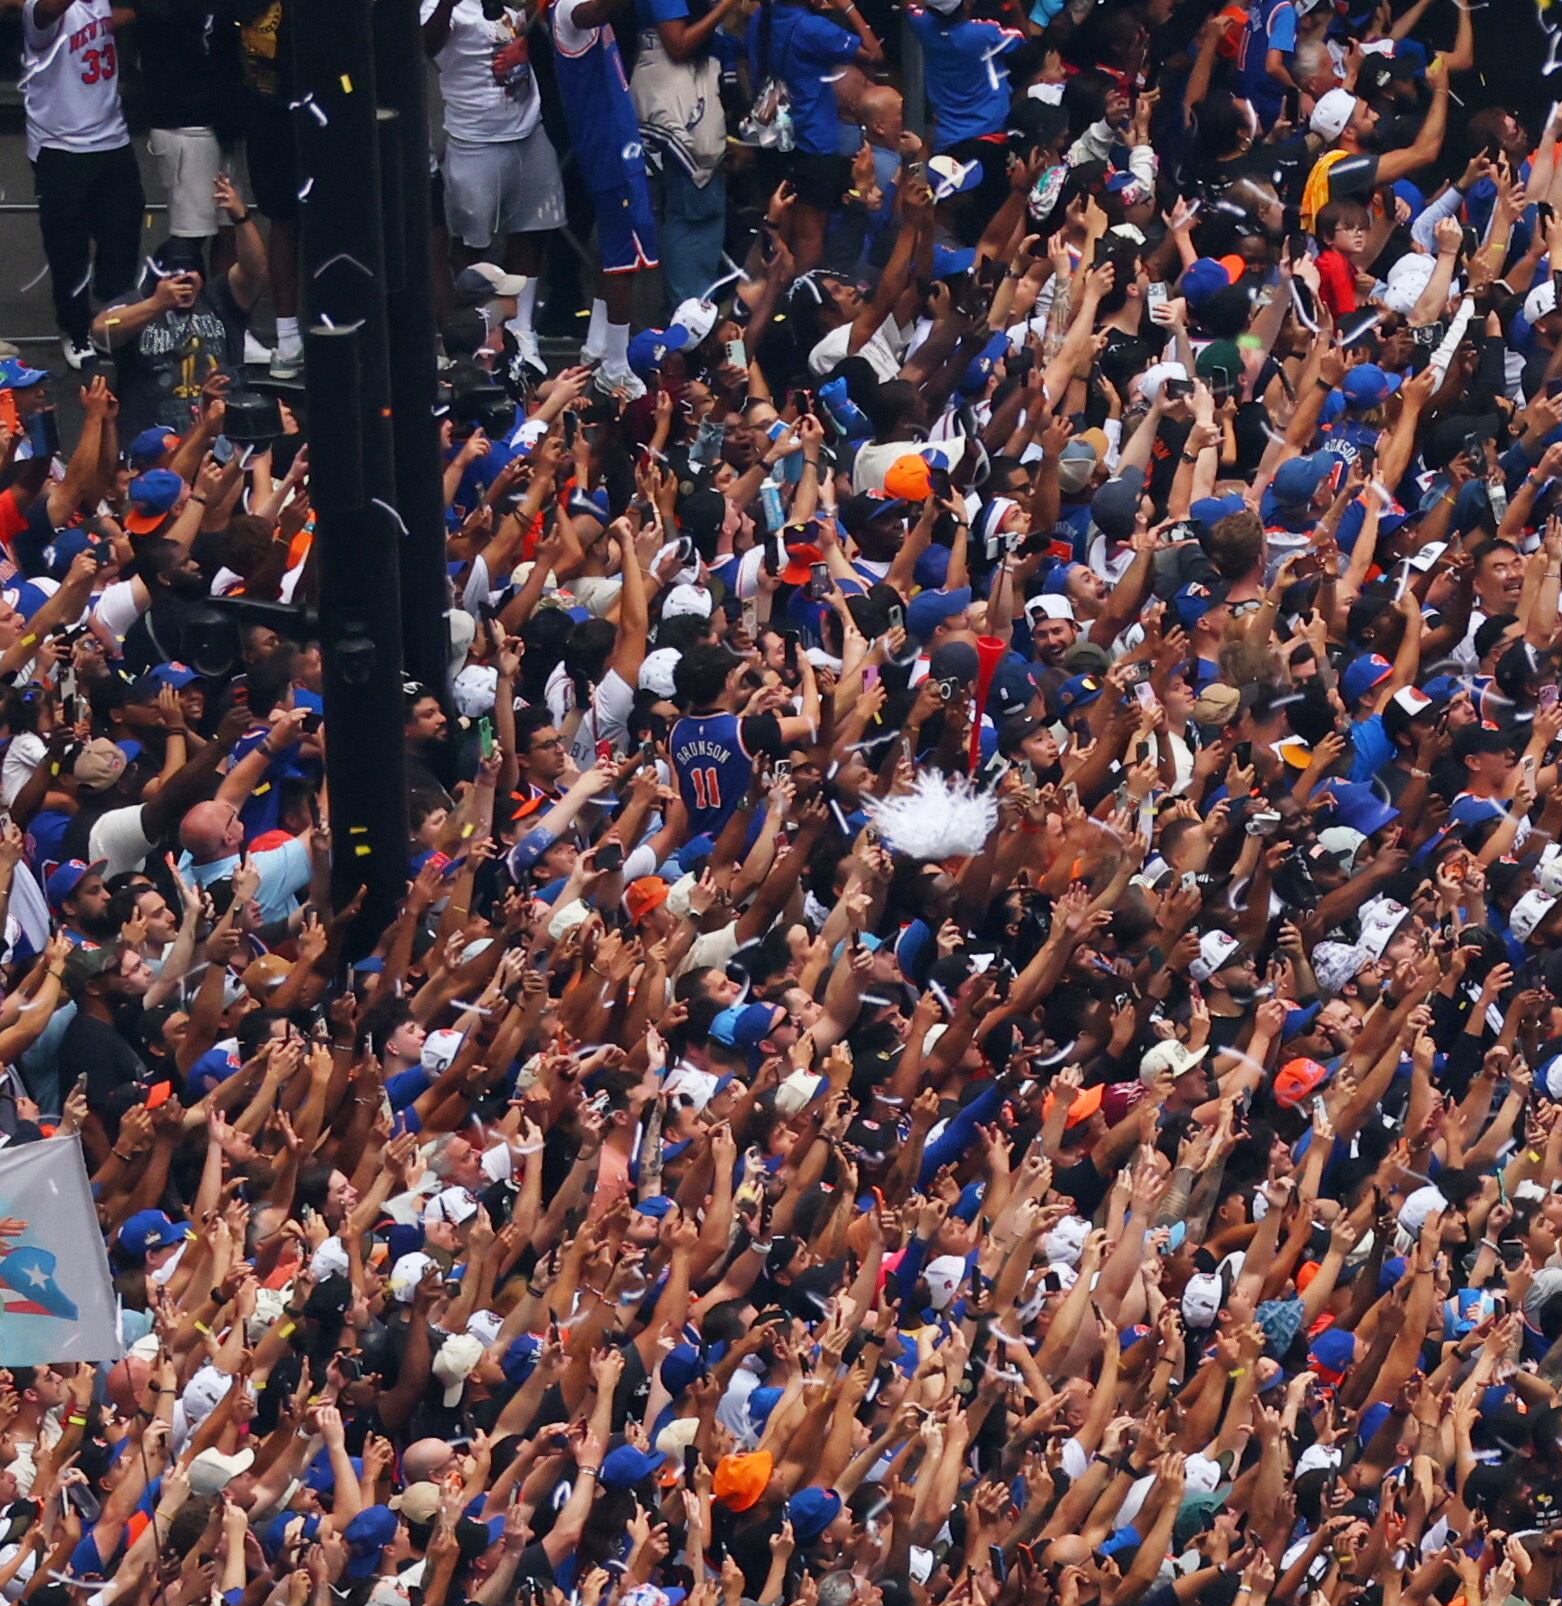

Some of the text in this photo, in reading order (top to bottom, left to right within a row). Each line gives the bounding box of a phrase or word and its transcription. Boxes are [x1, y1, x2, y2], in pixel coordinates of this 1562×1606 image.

[82, 43, 116, 85] 33
[677, 741, 731, 767] BRUNSON
[691, 767, 721, 810] 11
